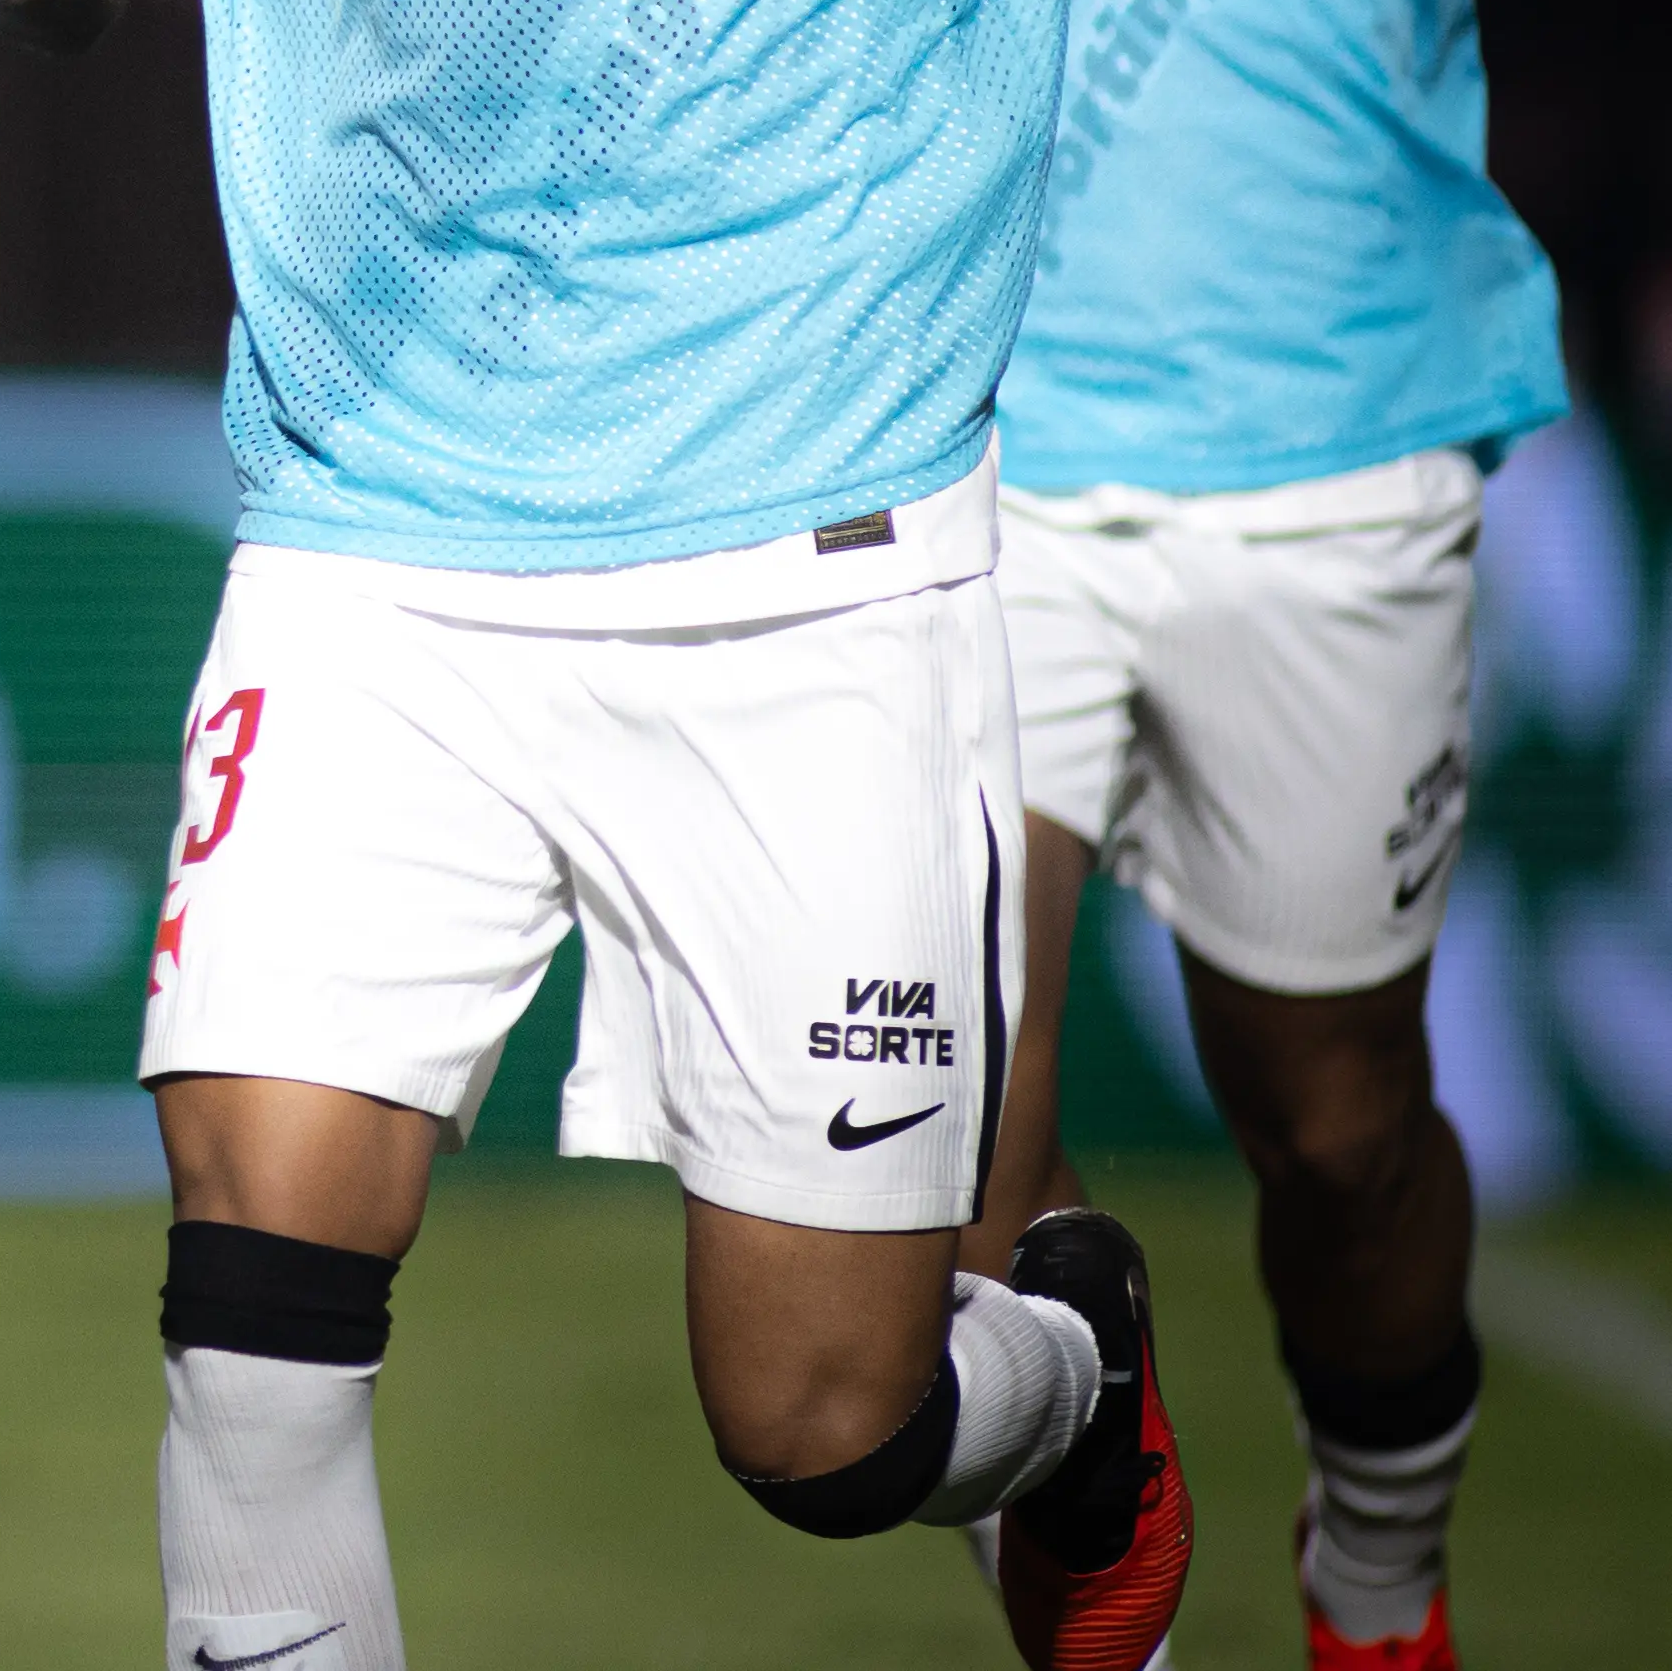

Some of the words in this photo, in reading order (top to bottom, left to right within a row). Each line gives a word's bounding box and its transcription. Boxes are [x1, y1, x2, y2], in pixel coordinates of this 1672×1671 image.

[180, 688, 266, 868] 3
[846, 978, 935, 1019] VIVA
[809, 1022, 954, 1066] SORTE
